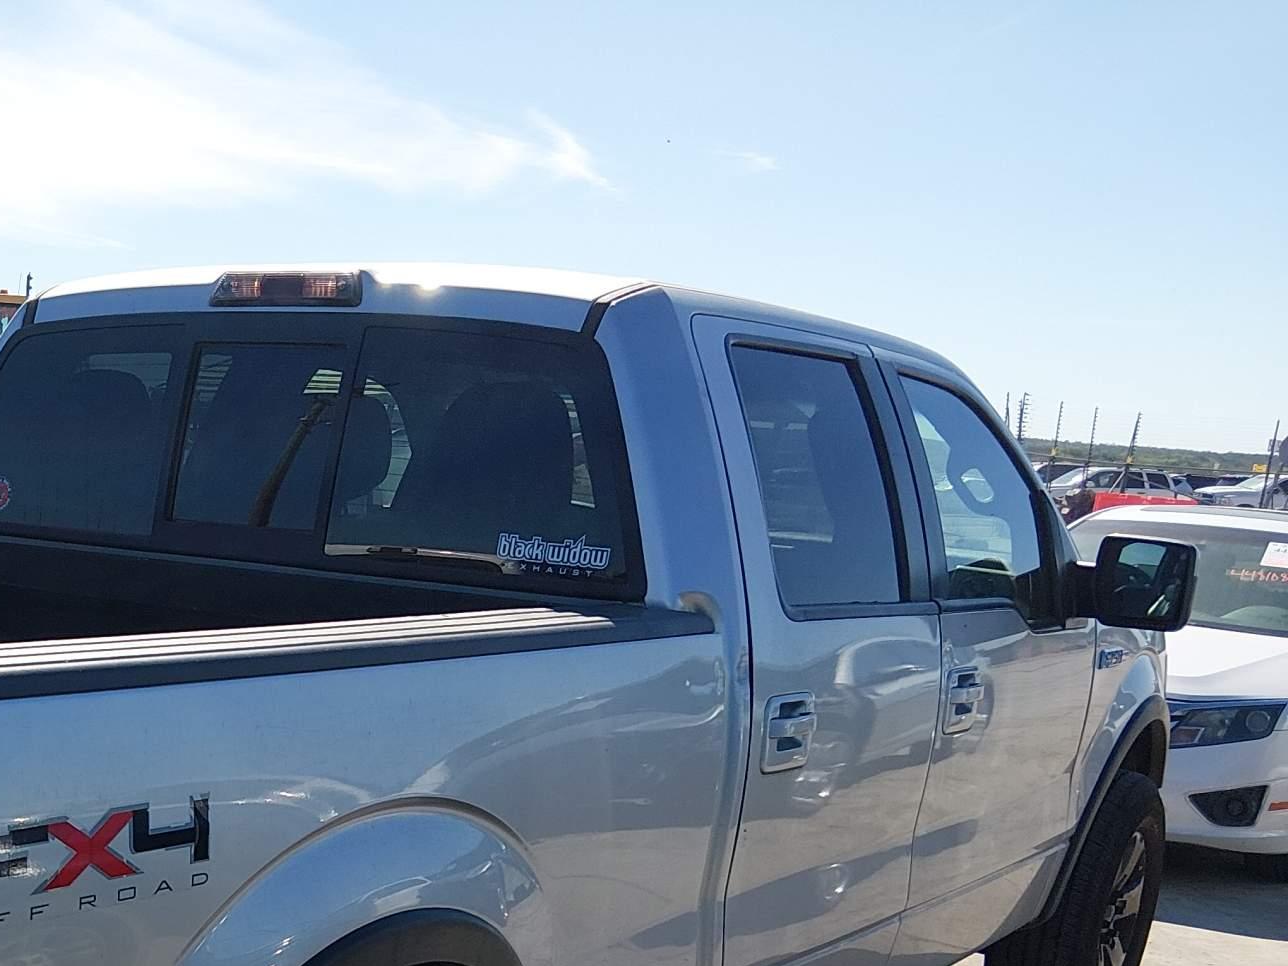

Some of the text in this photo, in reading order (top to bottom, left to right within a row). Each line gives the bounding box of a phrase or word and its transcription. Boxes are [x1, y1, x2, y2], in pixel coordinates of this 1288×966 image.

[497, 533, 611, 569] black widow
[507, 562, 593, 577] EXHAUST
